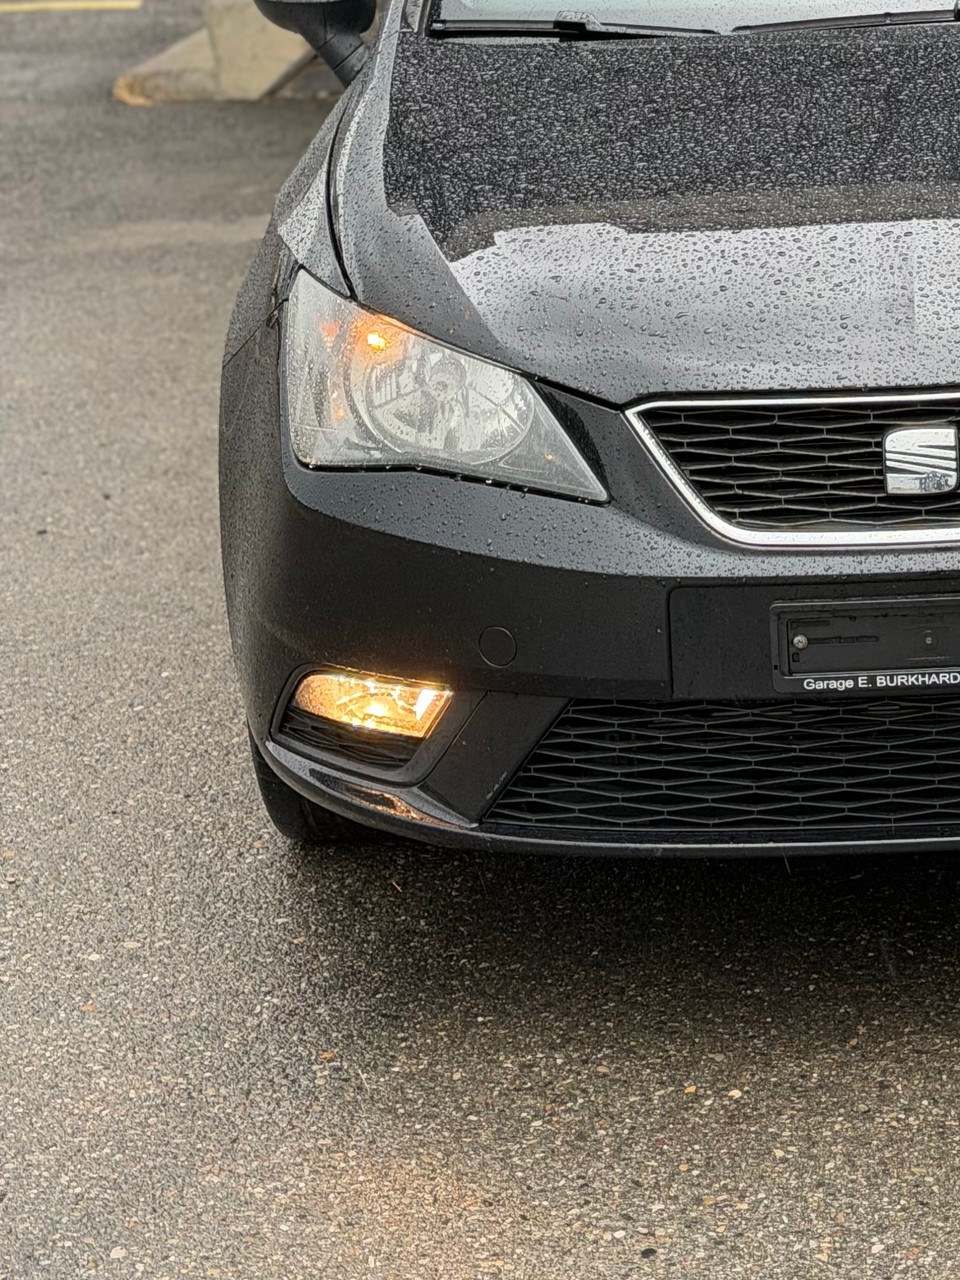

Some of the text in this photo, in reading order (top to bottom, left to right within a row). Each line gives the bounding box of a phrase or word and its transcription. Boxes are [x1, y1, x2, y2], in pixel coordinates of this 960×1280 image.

[803, 678, 854, 691] Garage
[857, 676, 872, 688] E.
[876, 673, 960, 687] BURKHARD
